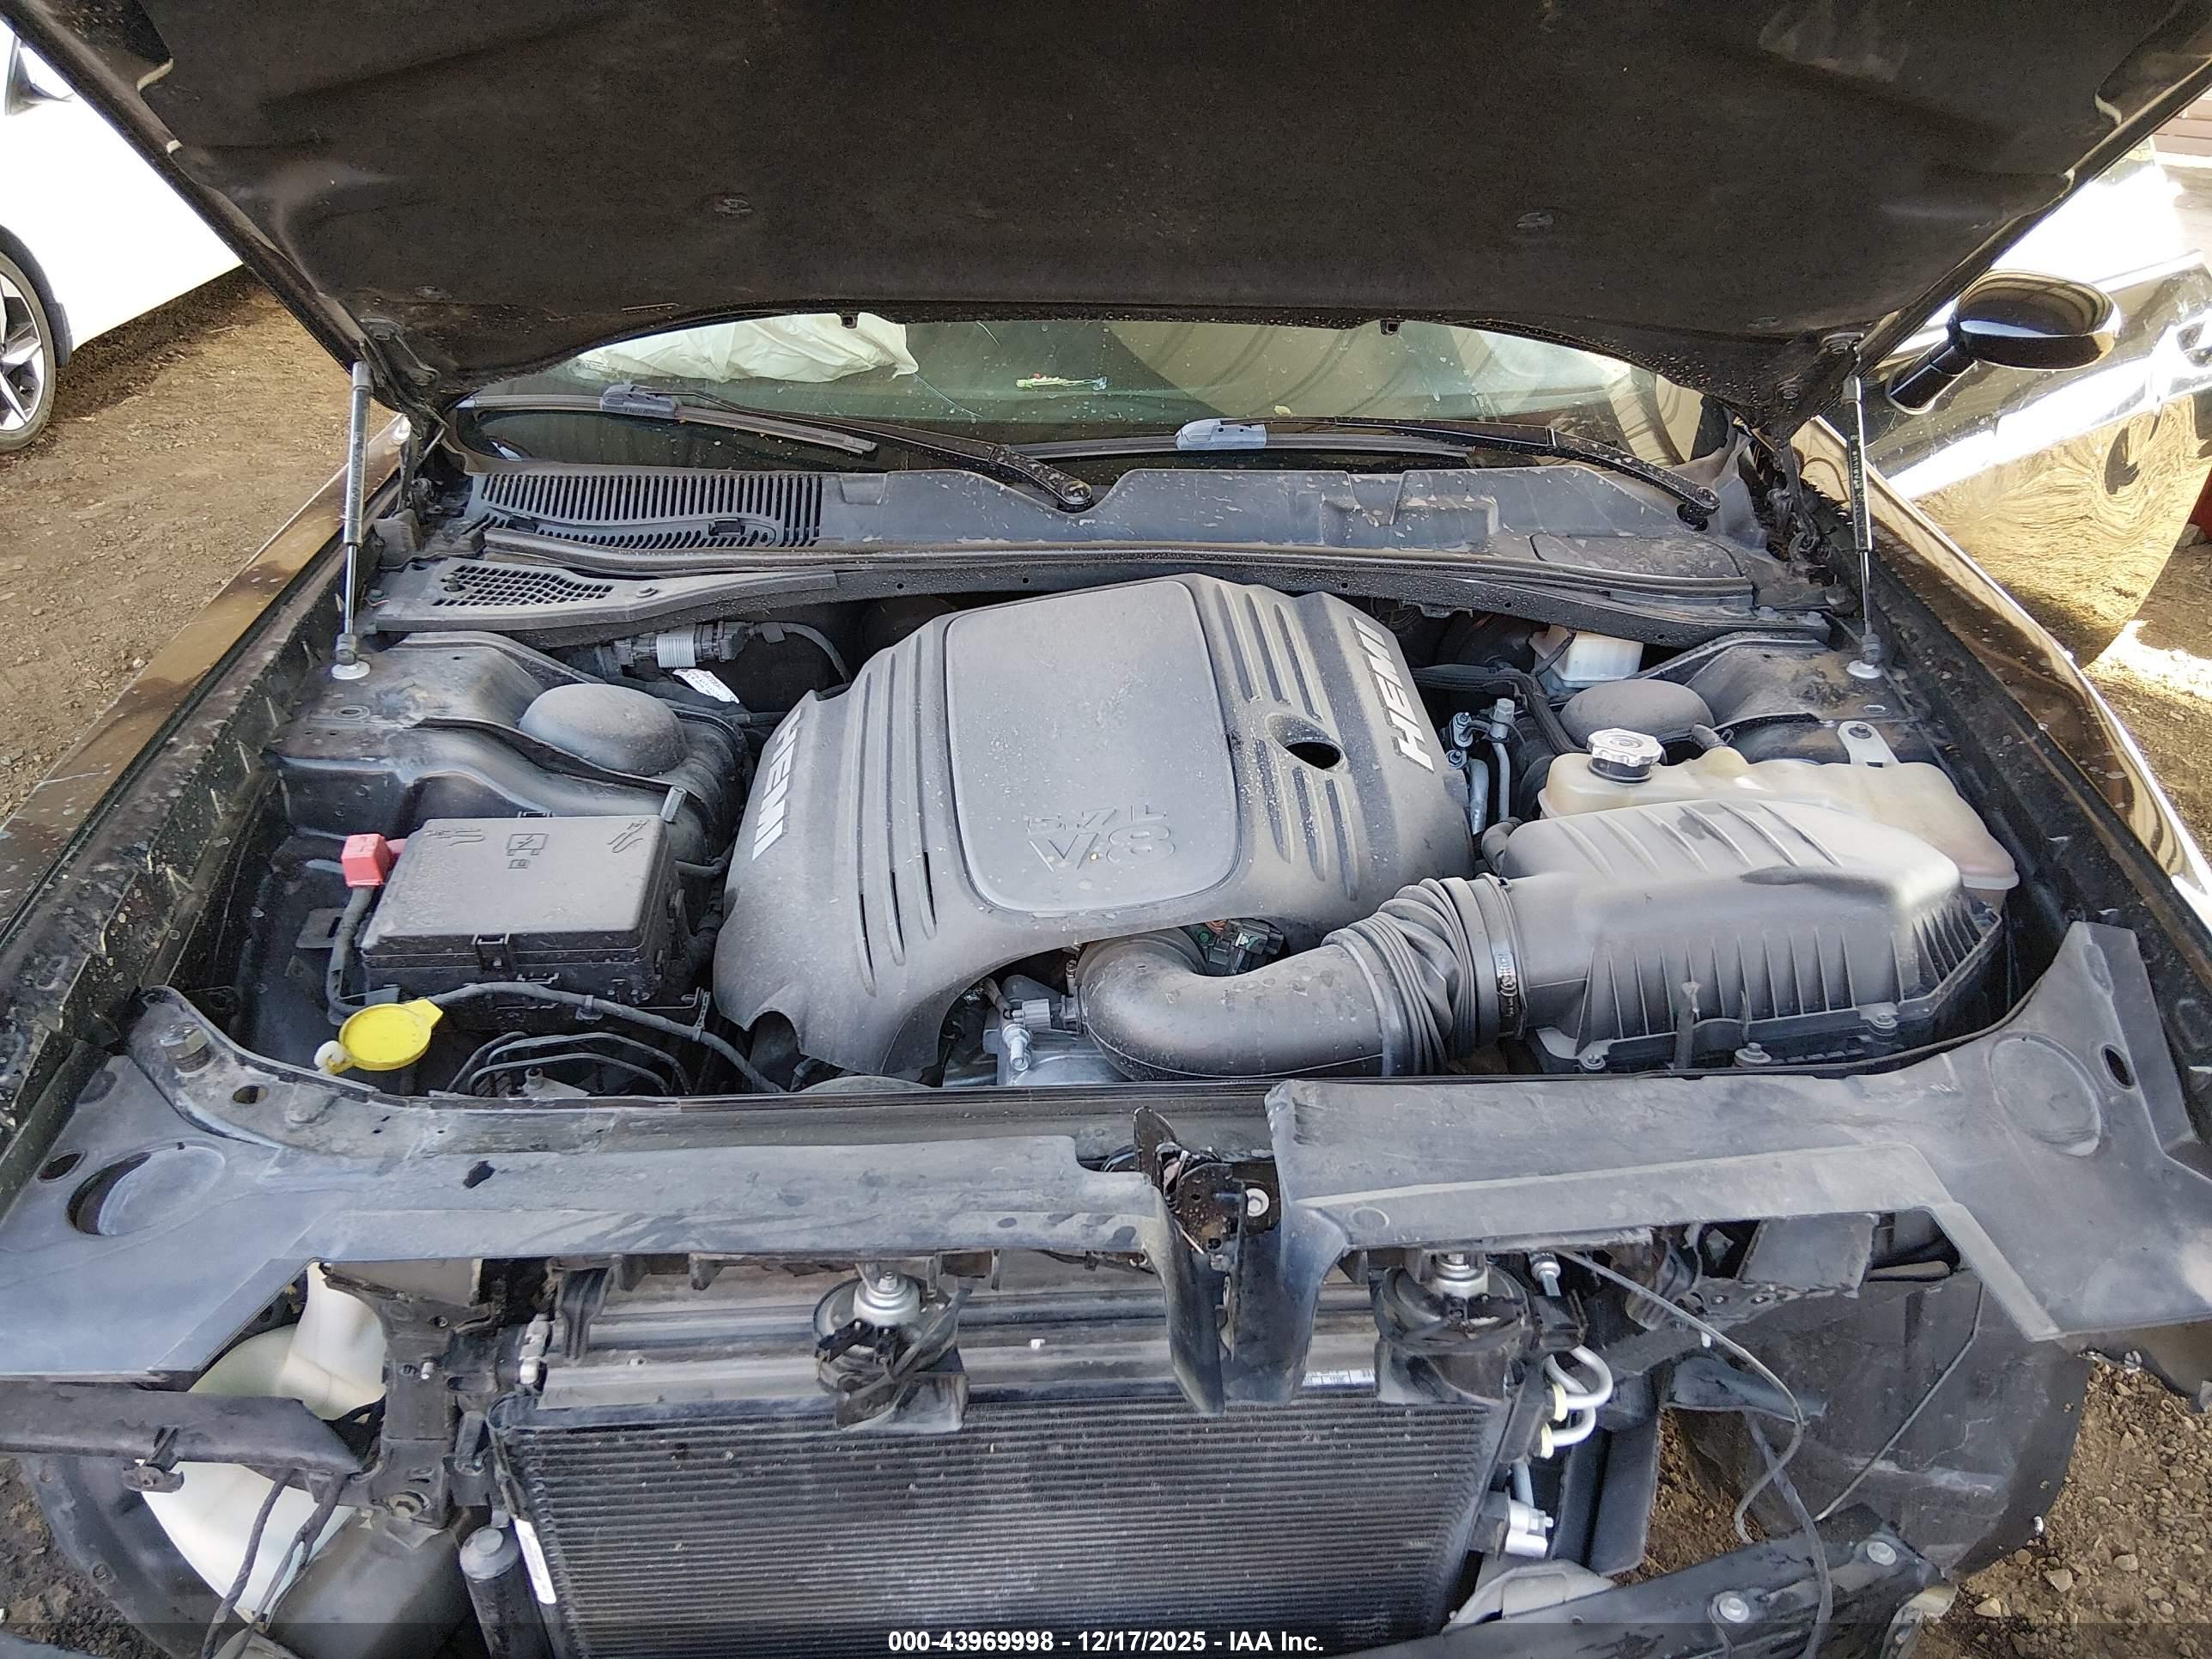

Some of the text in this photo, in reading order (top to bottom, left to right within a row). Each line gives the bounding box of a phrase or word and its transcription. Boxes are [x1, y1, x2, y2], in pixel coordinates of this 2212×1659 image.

[1352, 617, 1435, 773] HEMI
[752, 708, 802, 860] HEMI
[1028, 823, 1176, 873] V8
